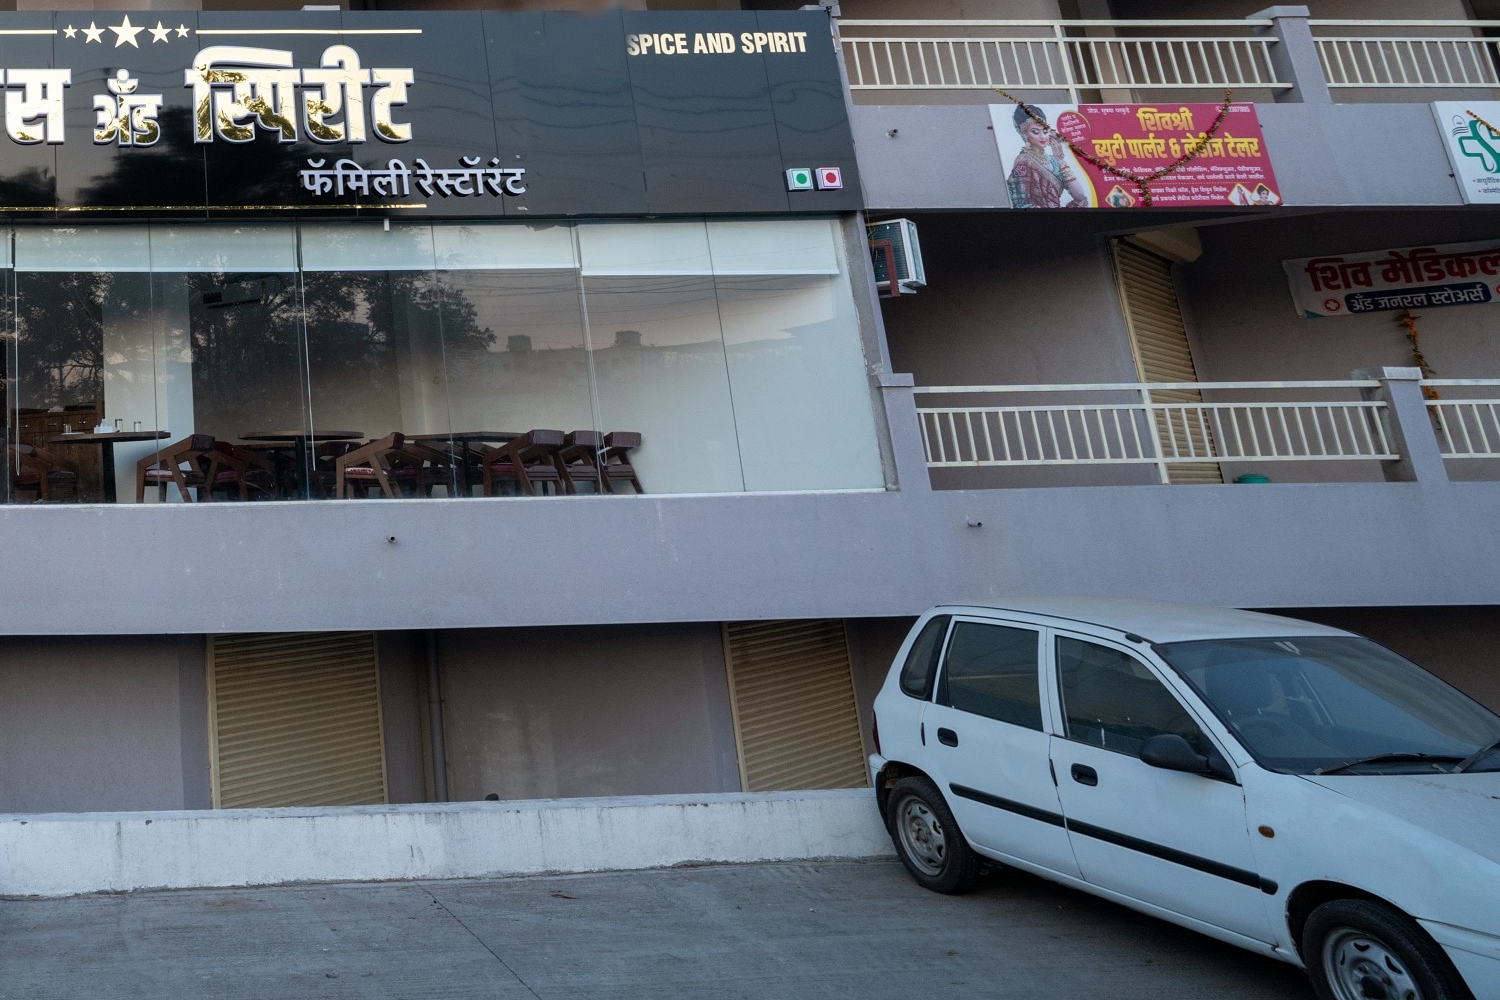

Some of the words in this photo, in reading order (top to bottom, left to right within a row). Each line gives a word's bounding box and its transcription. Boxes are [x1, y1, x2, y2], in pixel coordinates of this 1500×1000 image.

[627, 33, 689, 56] SPICE
[694, 32, 736, 54] AND
[741, 31, 808, 54] SPIRIT
[184, 44, 416, 147] स्पिरीट
[1136, 106, 1196, 132] शिवश्री
[1126, 132, 1168, 159] पार्लर
[1224, 131, 1262, 158] टेलर
[300, 158, 412, 197] फॅमिली
[414, 156, 528, 197] रेस्टॉरंट
[1304, 257, 1374, 292] शिव
[1374, 247, 1500, 284] मेडिकल
[1375, 291, 1428, 310] जनरल
[1430, 284, 1486, 306] स्टोअर्स
